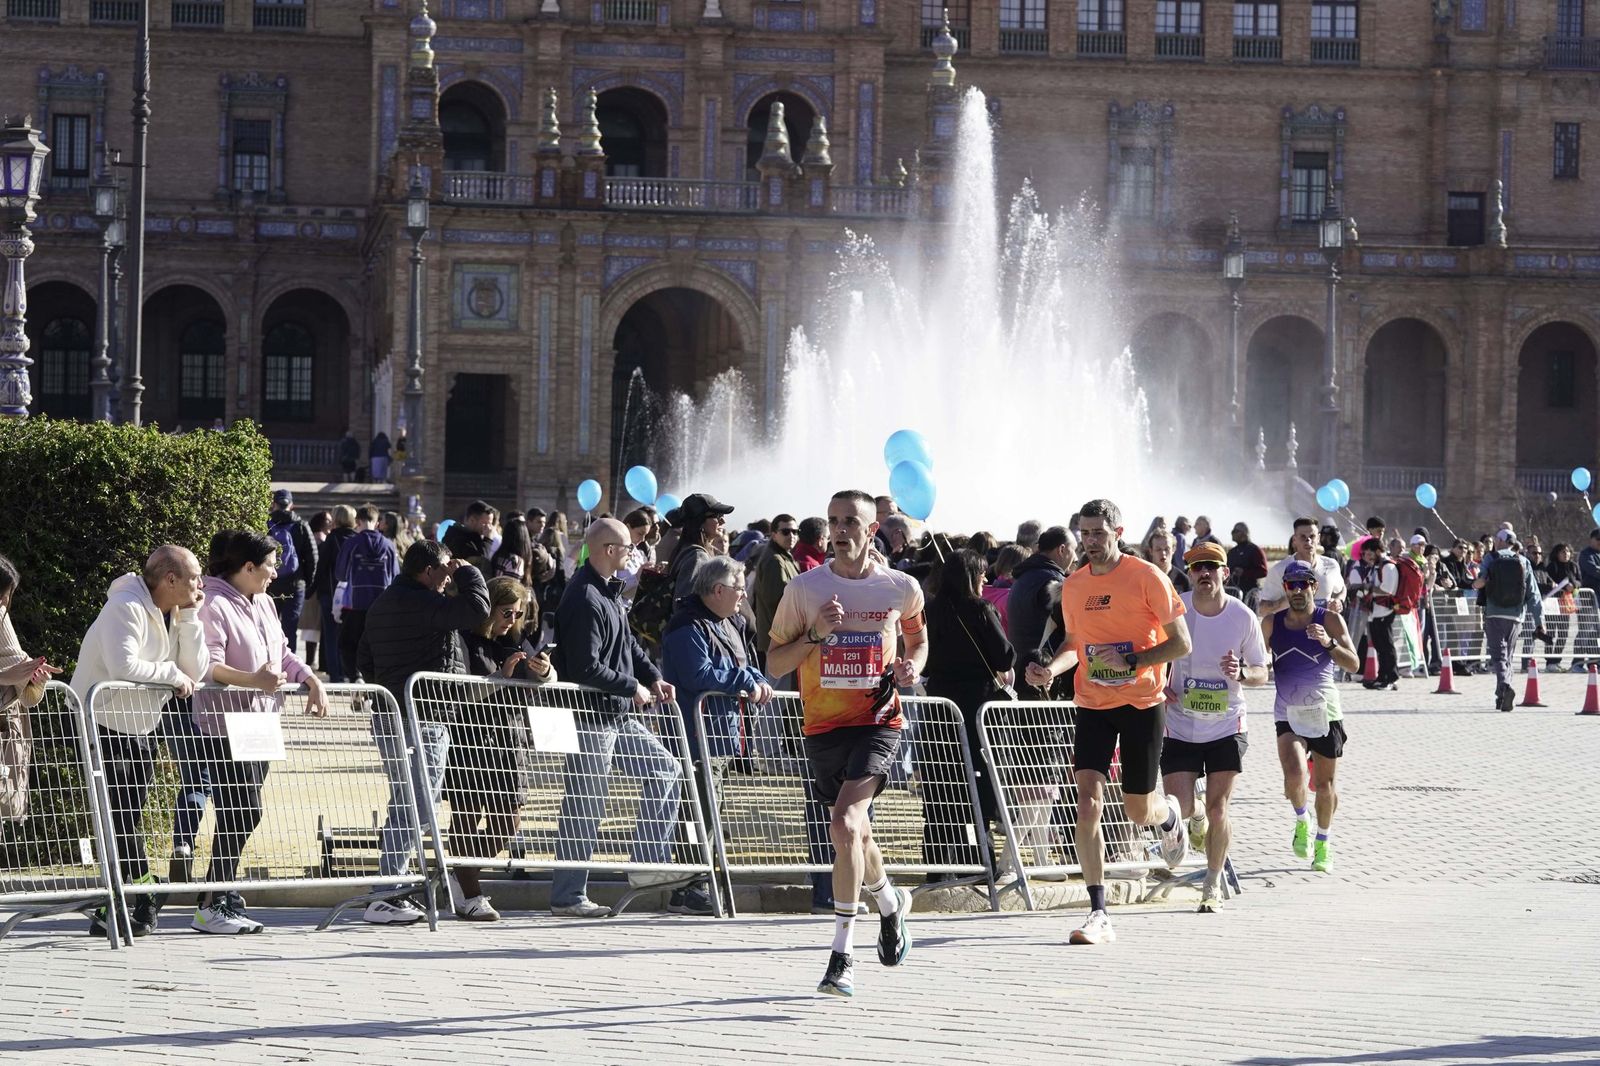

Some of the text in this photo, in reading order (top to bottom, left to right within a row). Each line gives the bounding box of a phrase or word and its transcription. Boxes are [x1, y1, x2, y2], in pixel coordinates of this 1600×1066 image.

[844, 608, 889, 622] ningzgz
[842, 635, 876, 644] ZURICH
[843, 652, 860, 661] 1291
[824, 663, 880, 675] MARIO BL
[1198, 682, 1223, 690] ZURICH
[1190, 700, 1221, 711] VICTOR
